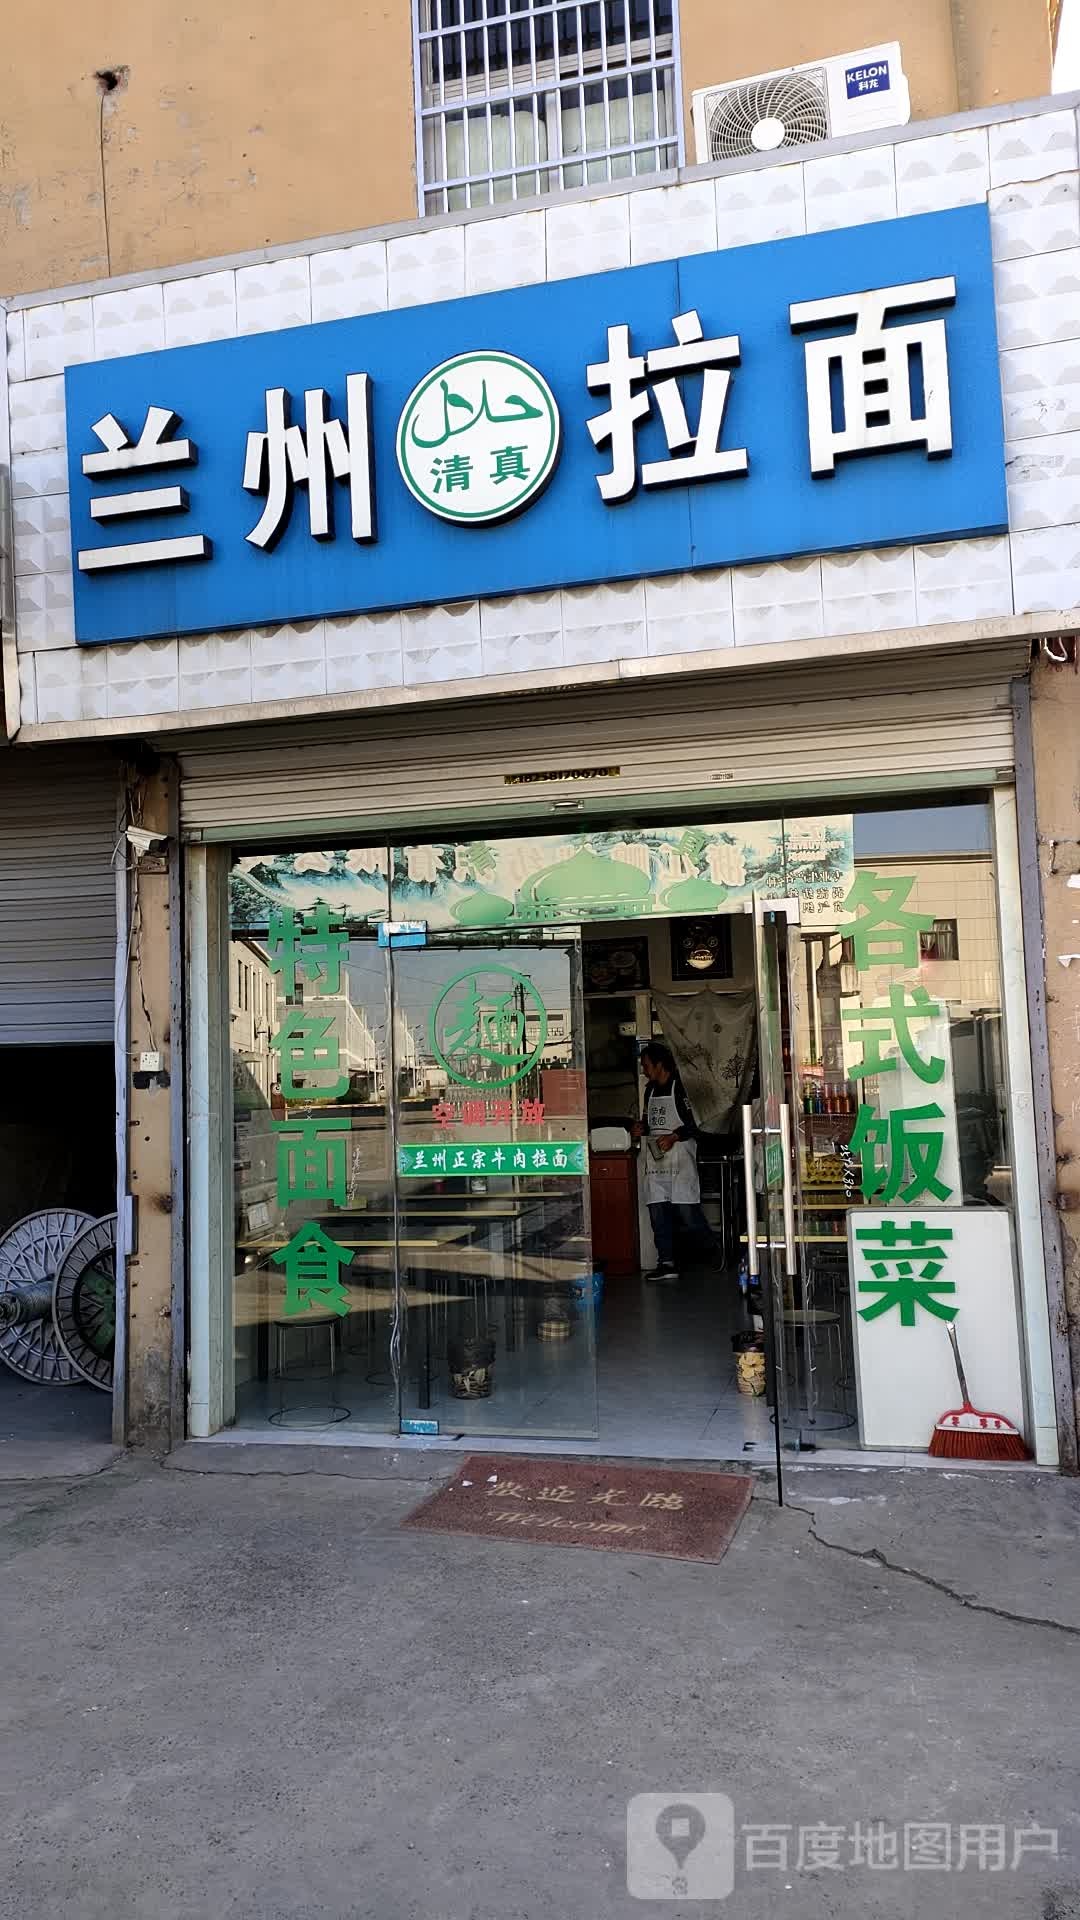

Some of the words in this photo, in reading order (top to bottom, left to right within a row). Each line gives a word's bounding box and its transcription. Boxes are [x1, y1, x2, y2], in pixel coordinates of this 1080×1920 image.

[847, 65, 888, 84] KELON
[858, 79, 879, 91] 科龙
[78, 373, 375, 573] 兰州
[586, 277, 956, 505] 拉面
[430, 445, 531, 494] 清真
[268, 904, 354, 1318] 特色面食
[432, 1098, 546, 1129] 空调开放
[837, 871, 960, 1326] 各式饭菜
[413, 1147, 569, 1171] 兰州正宗牛肉拉面
